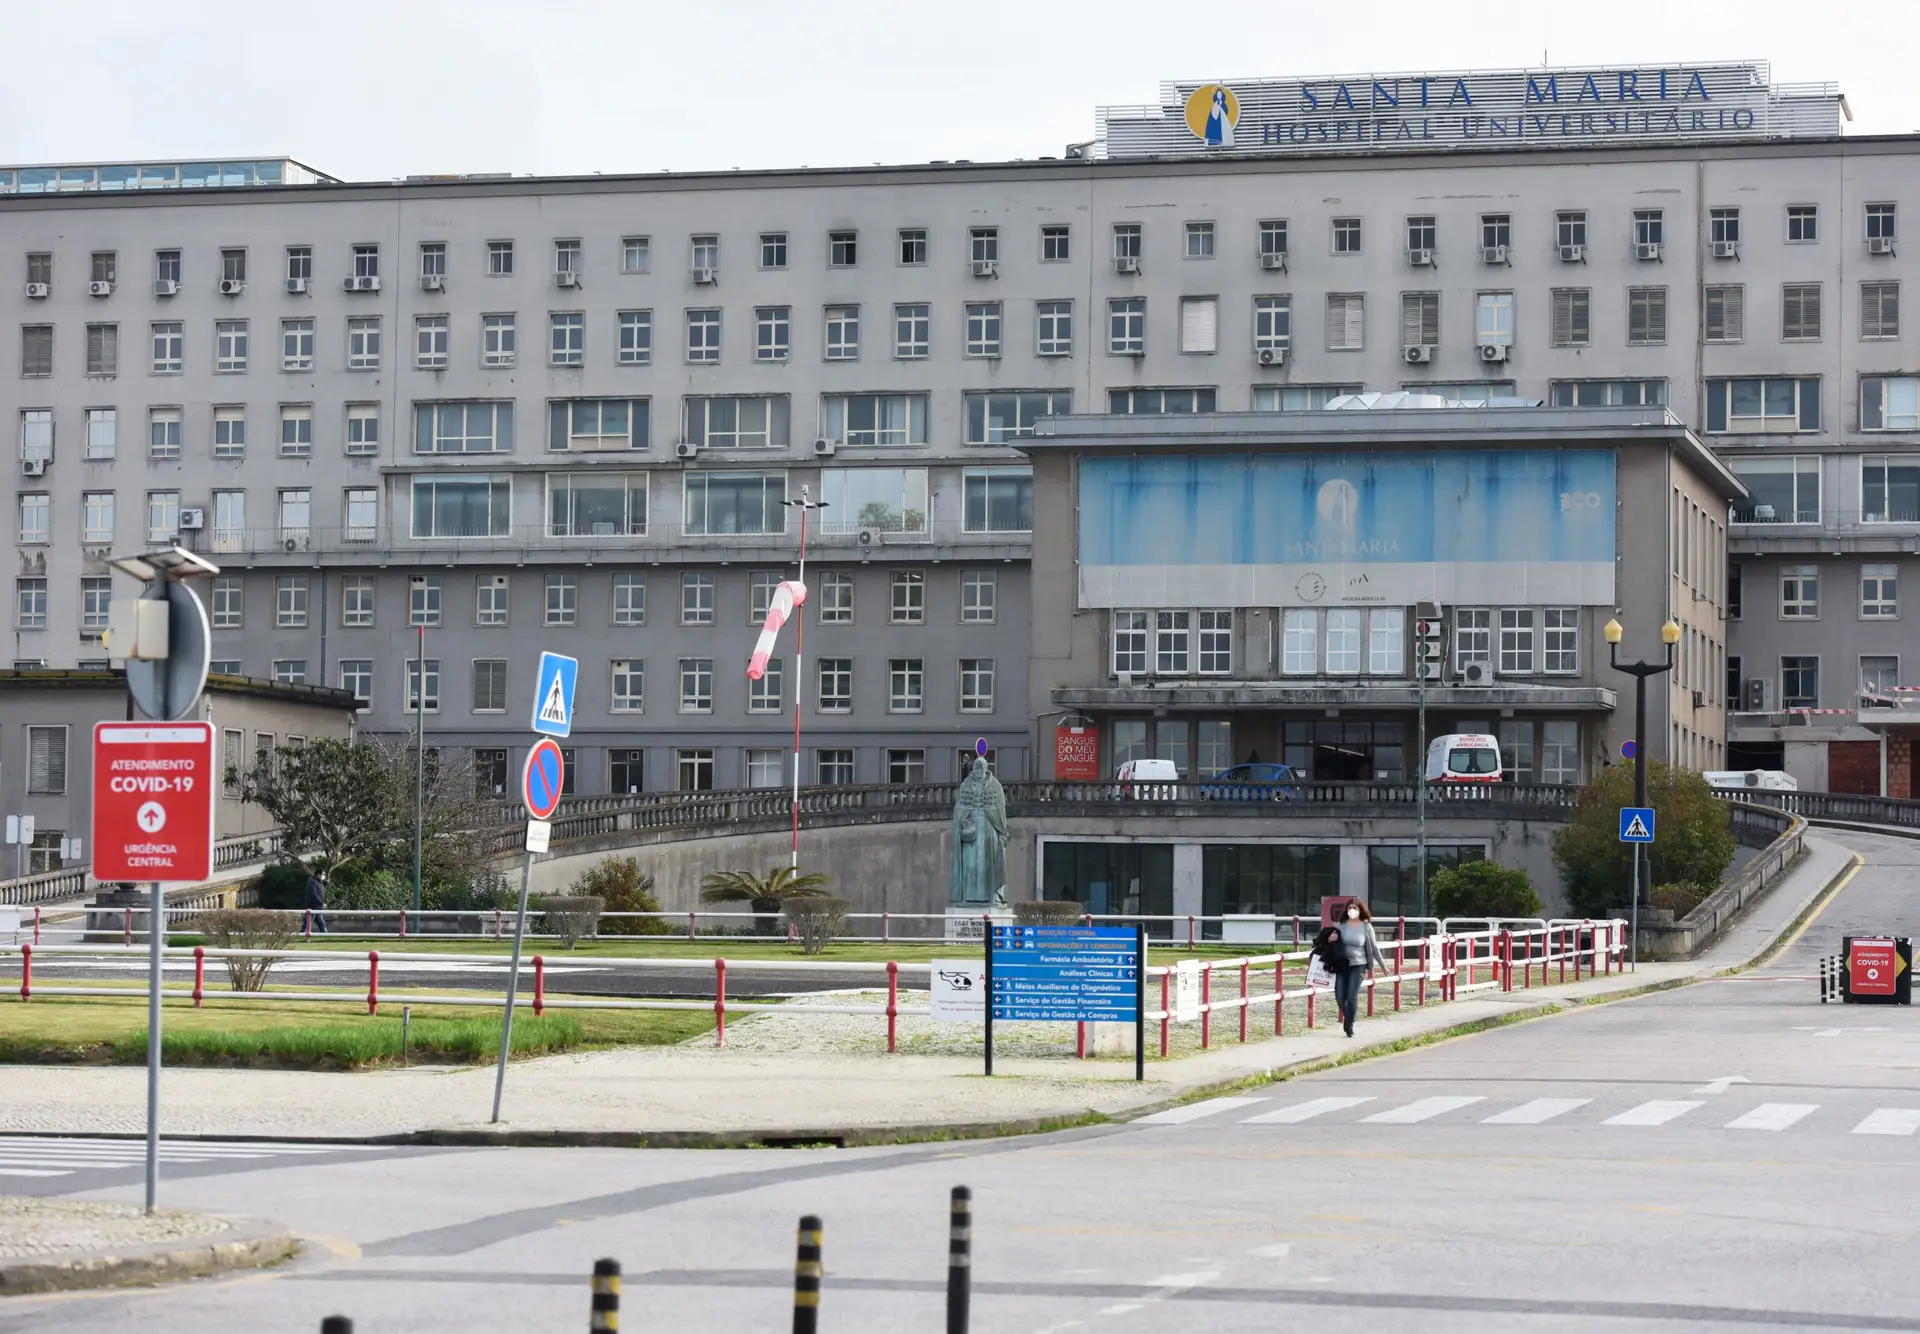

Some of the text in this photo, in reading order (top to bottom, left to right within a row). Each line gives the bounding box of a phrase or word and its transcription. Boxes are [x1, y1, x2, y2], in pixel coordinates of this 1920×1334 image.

[1301, 70, 1712, 112] SANTA MARIA
[1263, 107, 1755, 145] HOSPITAL UNIVERSITÁRIO
[1058, 736, 1096, 746] SANGUE
[1058, 745, 1096, 754] DO MEU
[1058, 753, 1096, 763] SANGUE
[111, 760, 195, 770] ATENDIMENTO
[111, 776, 194, 792] COVID-19
[124, 843, 177, 854] URGÊNCIA
[127, 857, 174, 867] CENTRAL
[1040, 955, 1114, 963] Farmácia Ambulatório
[1059, 969, 1113, 977] Análises Clínicas
[1015, 982, 1035, 990] Meios
[1081, 984, 1121, 992] Diagnóstico
[1015, 997, 1039, 1005] Serviço
[1015, 1010, 1039, 1019] Serviço
[1051, 1010, 1075, 1018] Gestão
[1087, 1011, 1118, 1020] Compras
